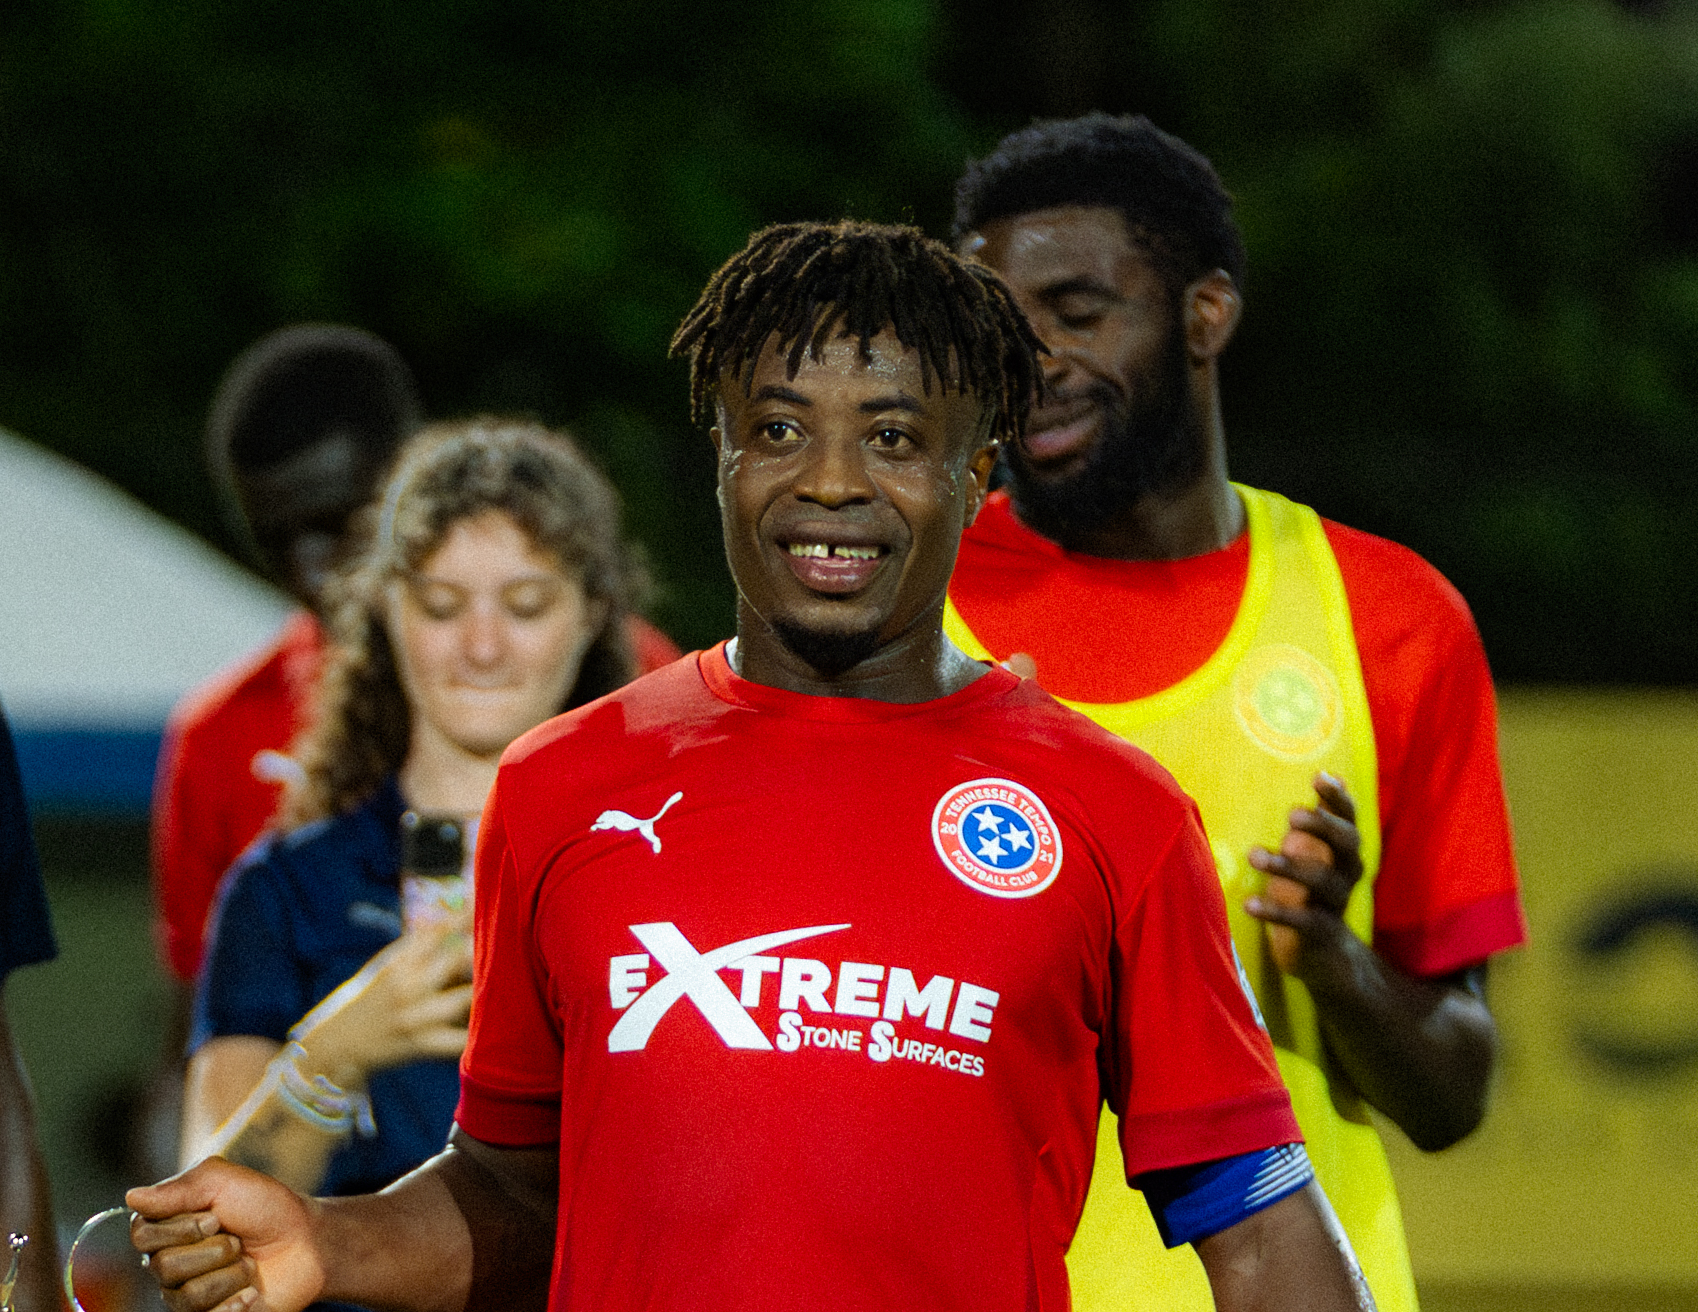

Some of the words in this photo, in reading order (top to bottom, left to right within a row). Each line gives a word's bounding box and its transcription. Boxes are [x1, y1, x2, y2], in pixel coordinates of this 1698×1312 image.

[940, 822, 958, 836] 20
[945, 787, 1018, 818] TENNESSEE
[1018, 798, 1052, 845] TEMPO
[951, 849, 1009, 887] FOOTBALL
[1009, 870, 1038, 887] CLUB
[1039, 849, 1053, 865] 21
